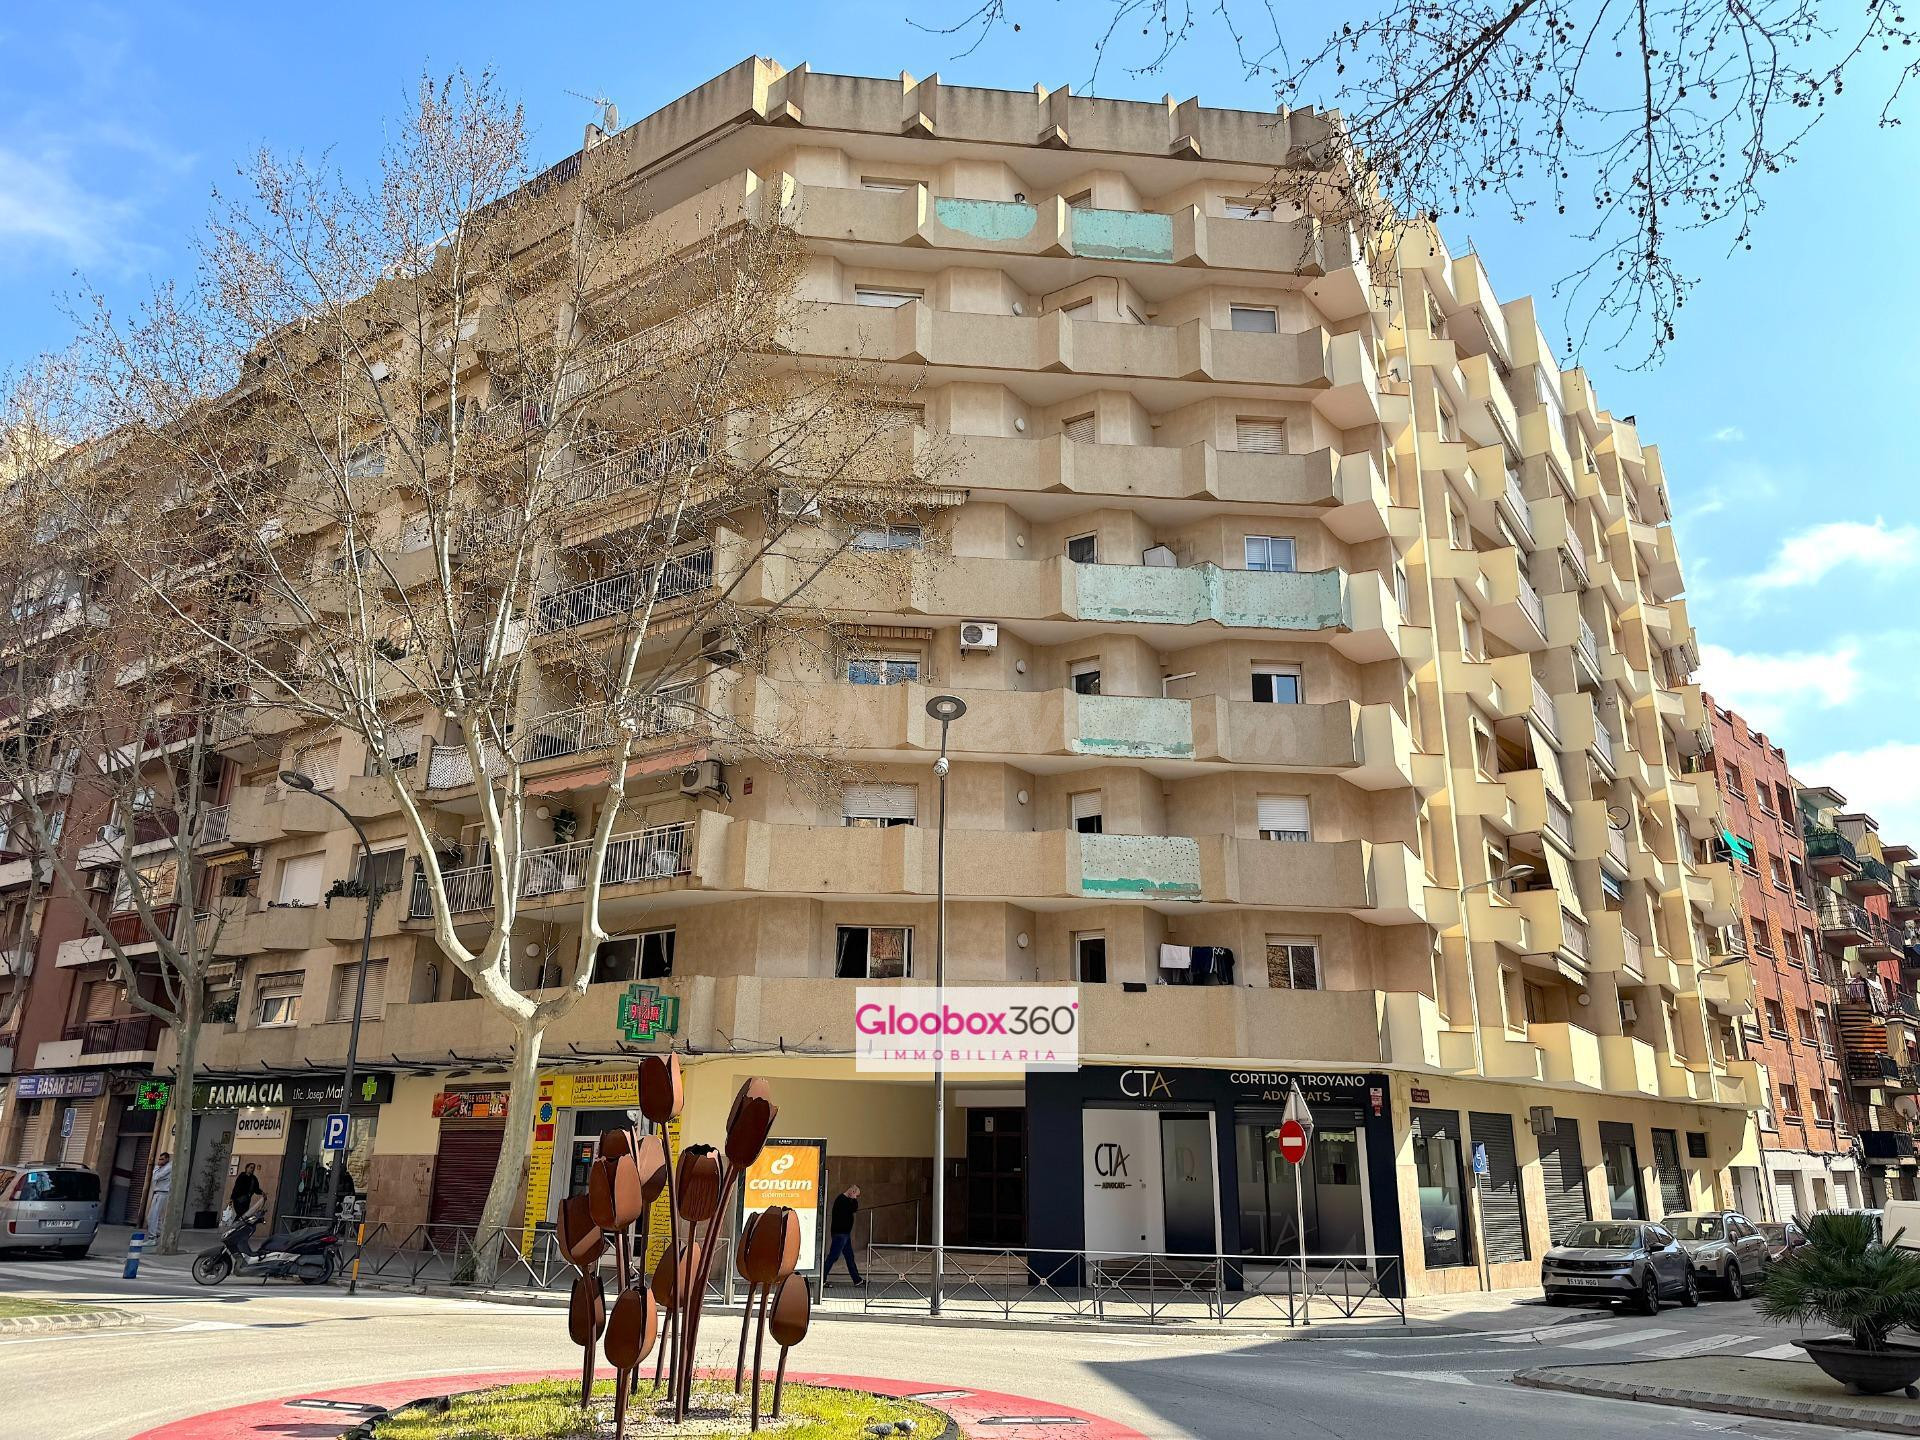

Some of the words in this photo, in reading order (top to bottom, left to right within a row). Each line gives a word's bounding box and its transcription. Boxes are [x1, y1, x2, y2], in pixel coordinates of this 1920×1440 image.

[36, 1077, 66, 1095] BASAR
[66, 1076, 84, 1094] EMI
[1119, 1069, 1176, 1098] CTA
[1230, 1073, 1288, 1085] CORTIJO
[1299, 1075, 1366, 1087] TROYANO
[305, 1088, 324, 1103] Josep
[1262, 1091, 1331, 1102] ADVCATS
[328, 1118, 344, 1146] P
[1095, 1143, 1130, 1177] CTA
[749, 1178, 812, 1191] consum
